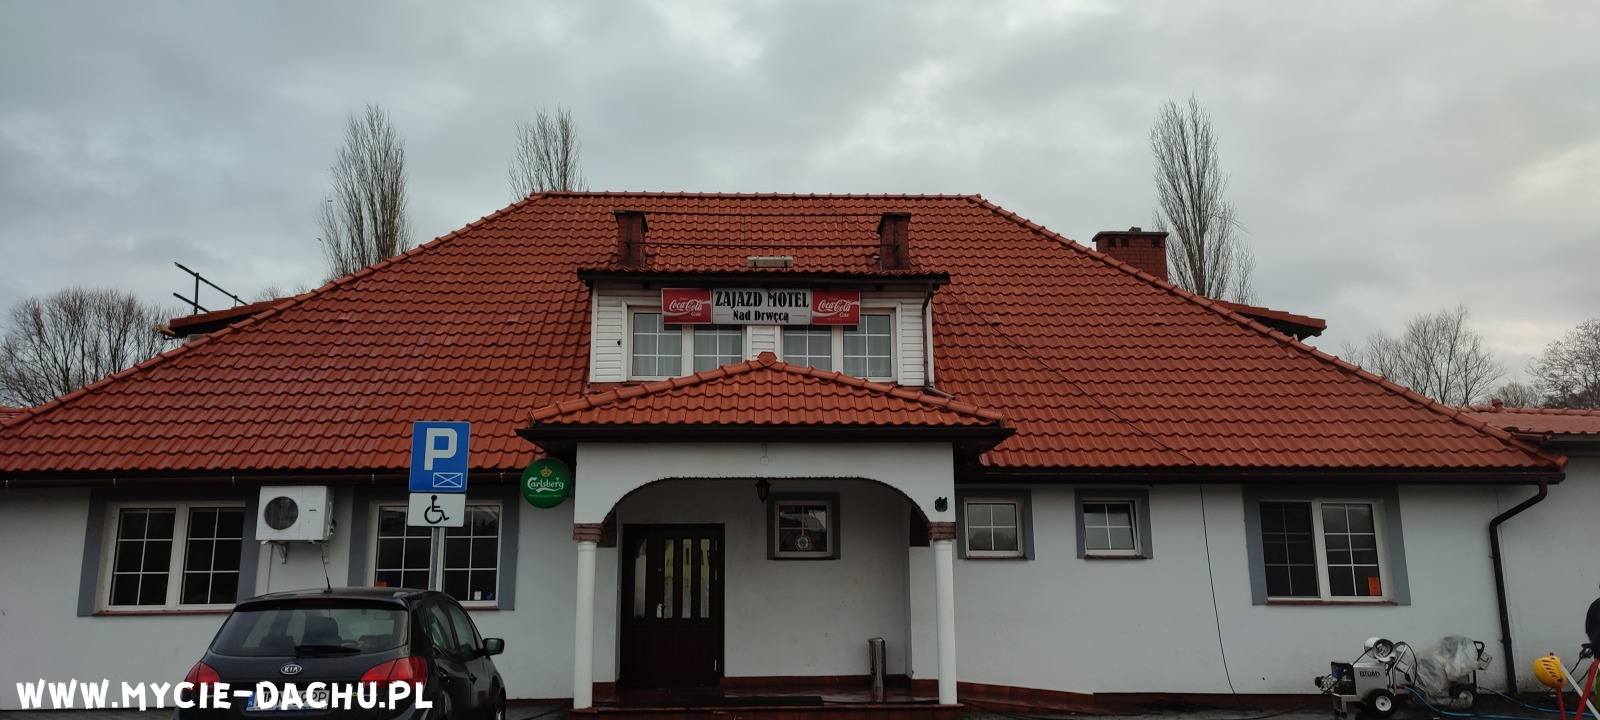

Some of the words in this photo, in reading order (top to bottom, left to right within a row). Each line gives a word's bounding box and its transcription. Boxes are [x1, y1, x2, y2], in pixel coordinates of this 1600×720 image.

[715, 291, 763, 309] ZAJAZD
[767, 291, 809, 308] MOTEL
[733, 310, 751, 321] Nad
[754, 310, 789, 323] Drwęcą
[424, 428, 458, 471] P
[527, 477, 564, 491] Carlsberg
[283, 665, 299, 673] KIA
